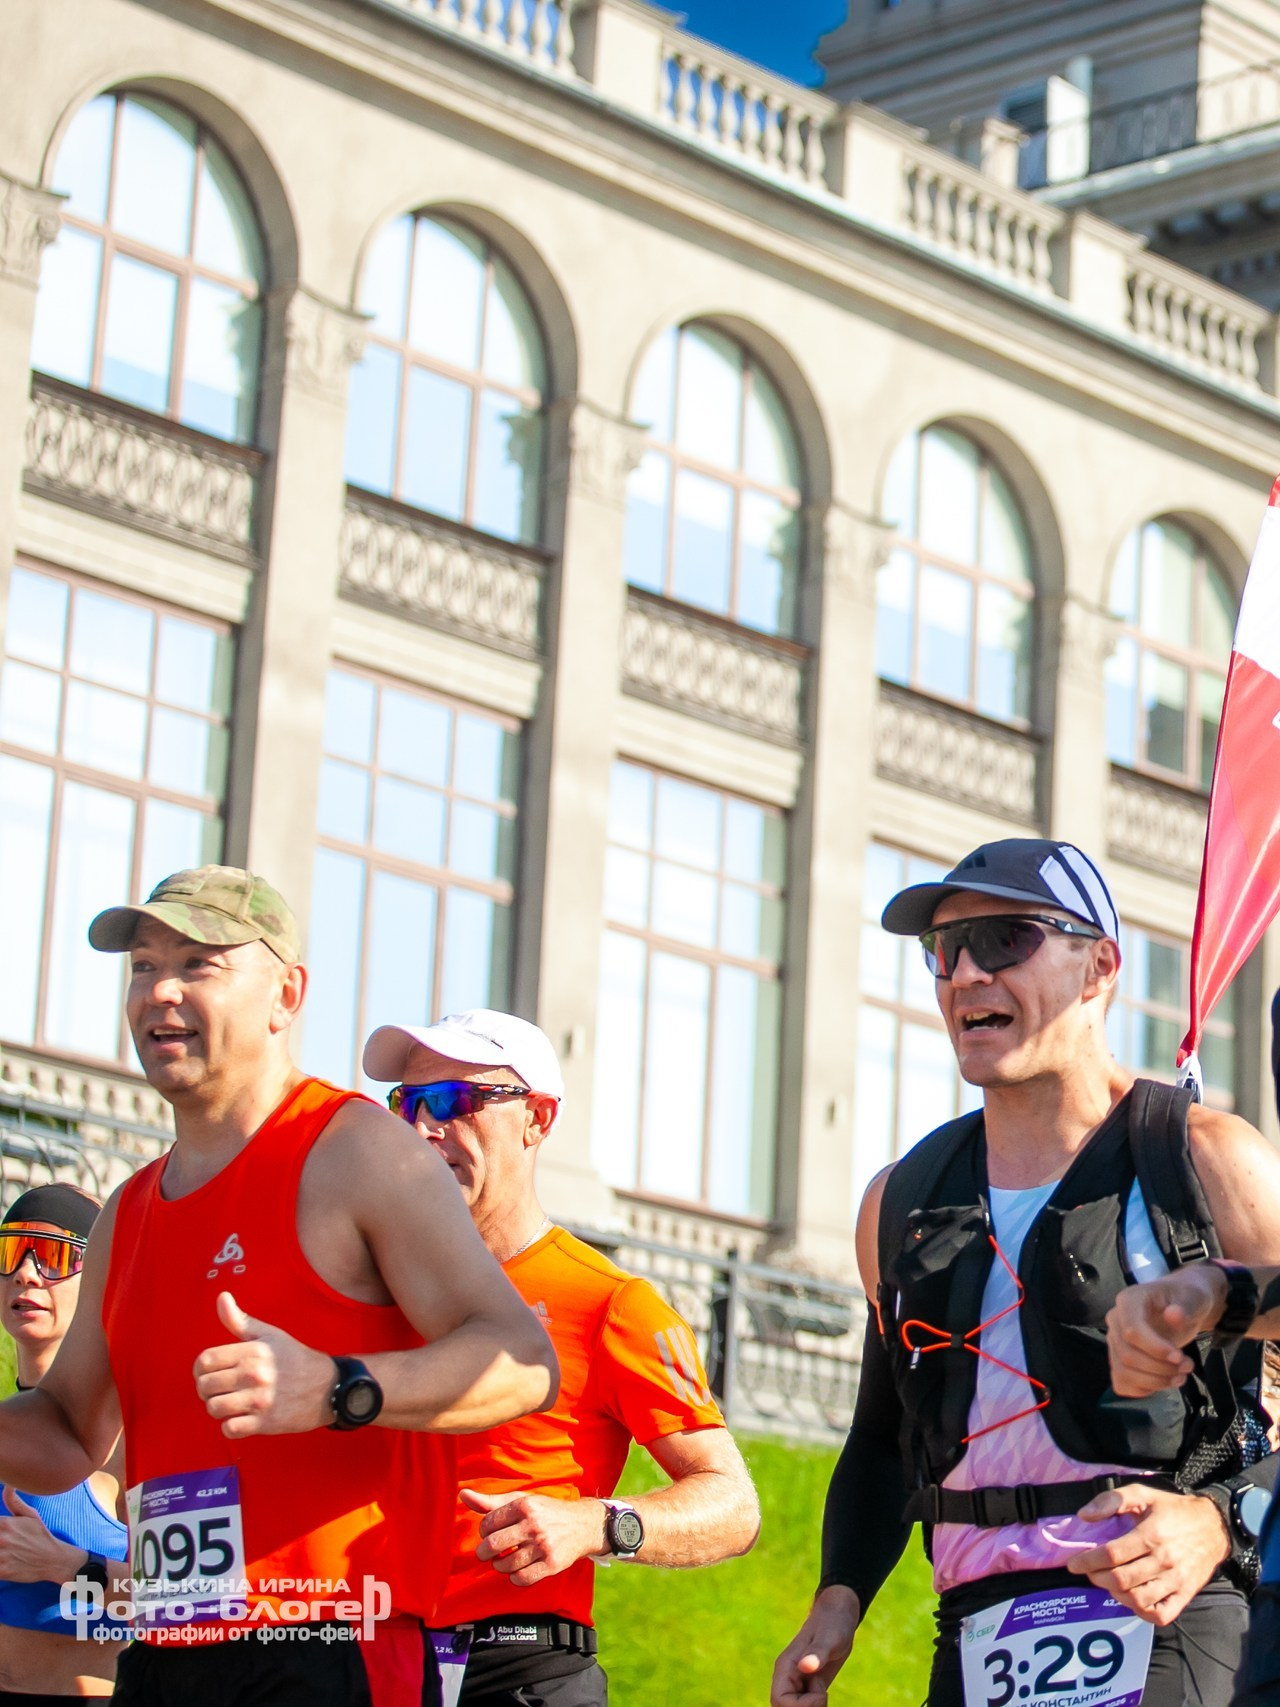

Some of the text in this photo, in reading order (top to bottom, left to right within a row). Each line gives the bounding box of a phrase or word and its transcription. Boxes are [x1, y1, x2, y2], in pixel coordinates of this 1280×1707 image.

[1013, 1595, 1087, 1616] КРАСНОЯРСКИЕ
[1032, 1606, 1067, 1619] МОСТЫ
[497, 1625, 537, 1634] Abu Dhabi
[497, 1633, 538, 1642] Sports Council
[984, 1629, 1126, 1707] 3:29
[1030, 1686, 1112, 1707] КОНСТАНТИН
